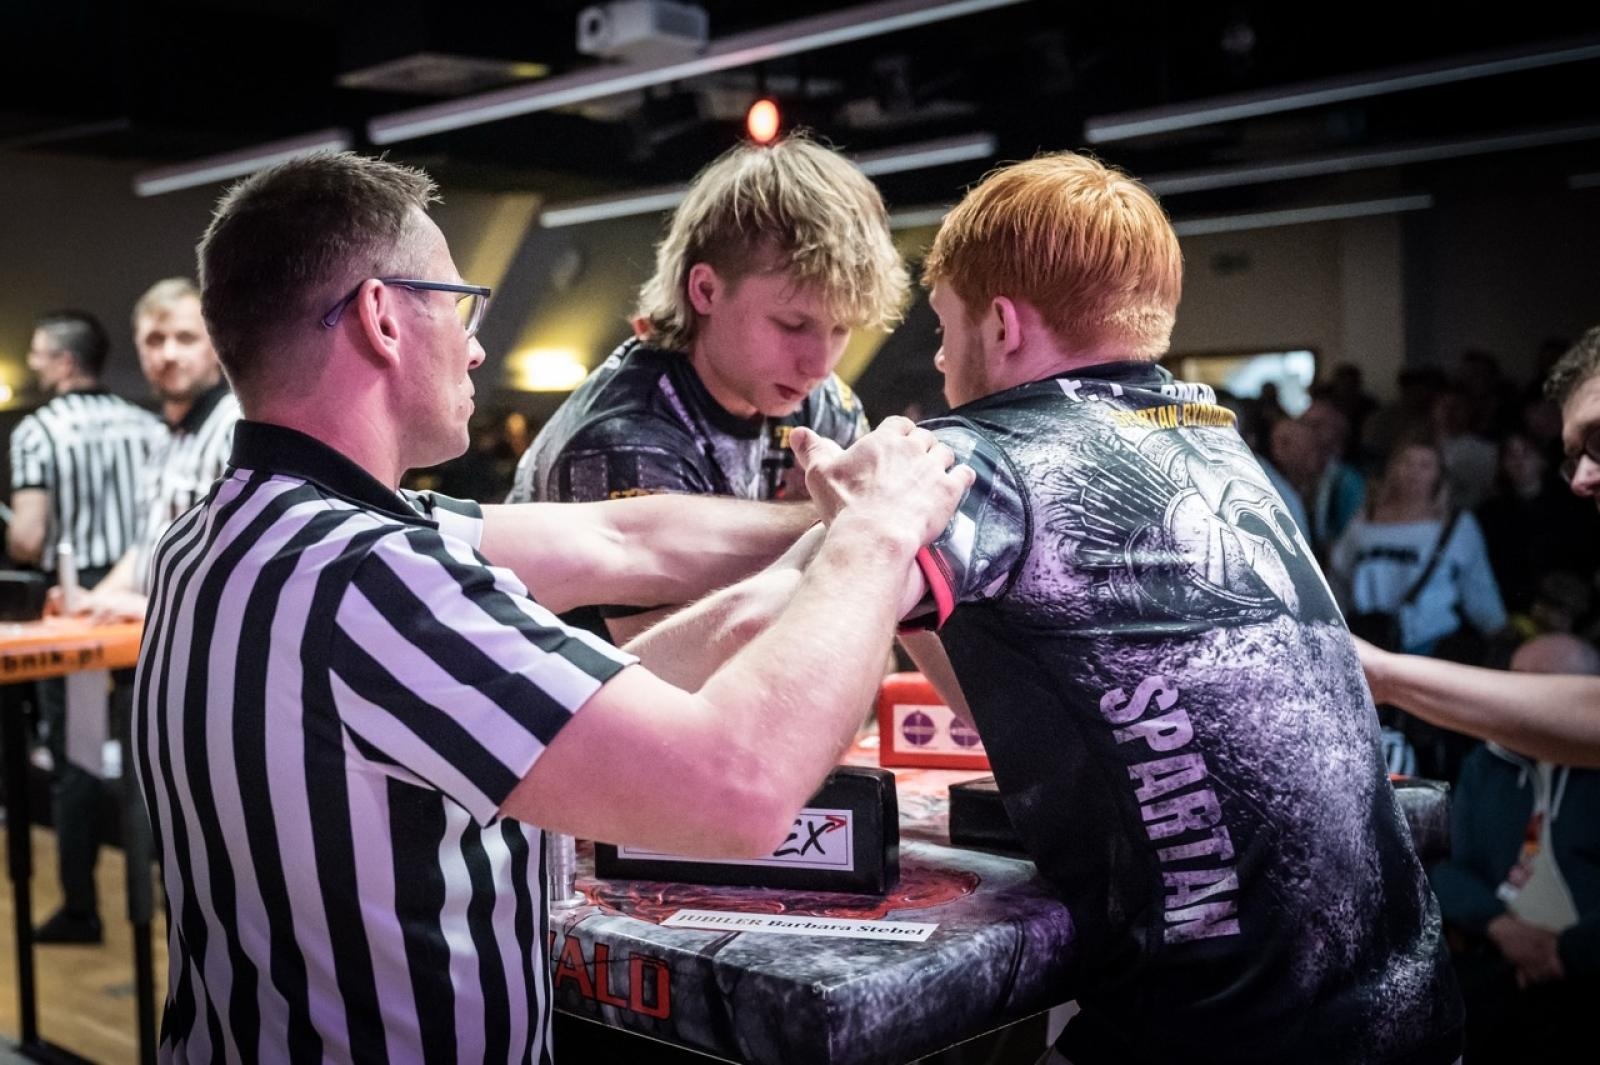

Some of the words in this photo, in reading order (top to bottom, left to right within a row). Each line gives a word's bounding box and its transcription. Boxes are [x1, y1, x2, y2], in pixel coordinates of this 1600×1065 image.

[1108, 404, 1179, 429] SPARTAN
[1099, 674, 1241, 945] SPARTAN
[676, 913, 762, 927] JUBILER
[767, 919, 852, 932] Barbara
[856, 924, 925, 937] Stebel
